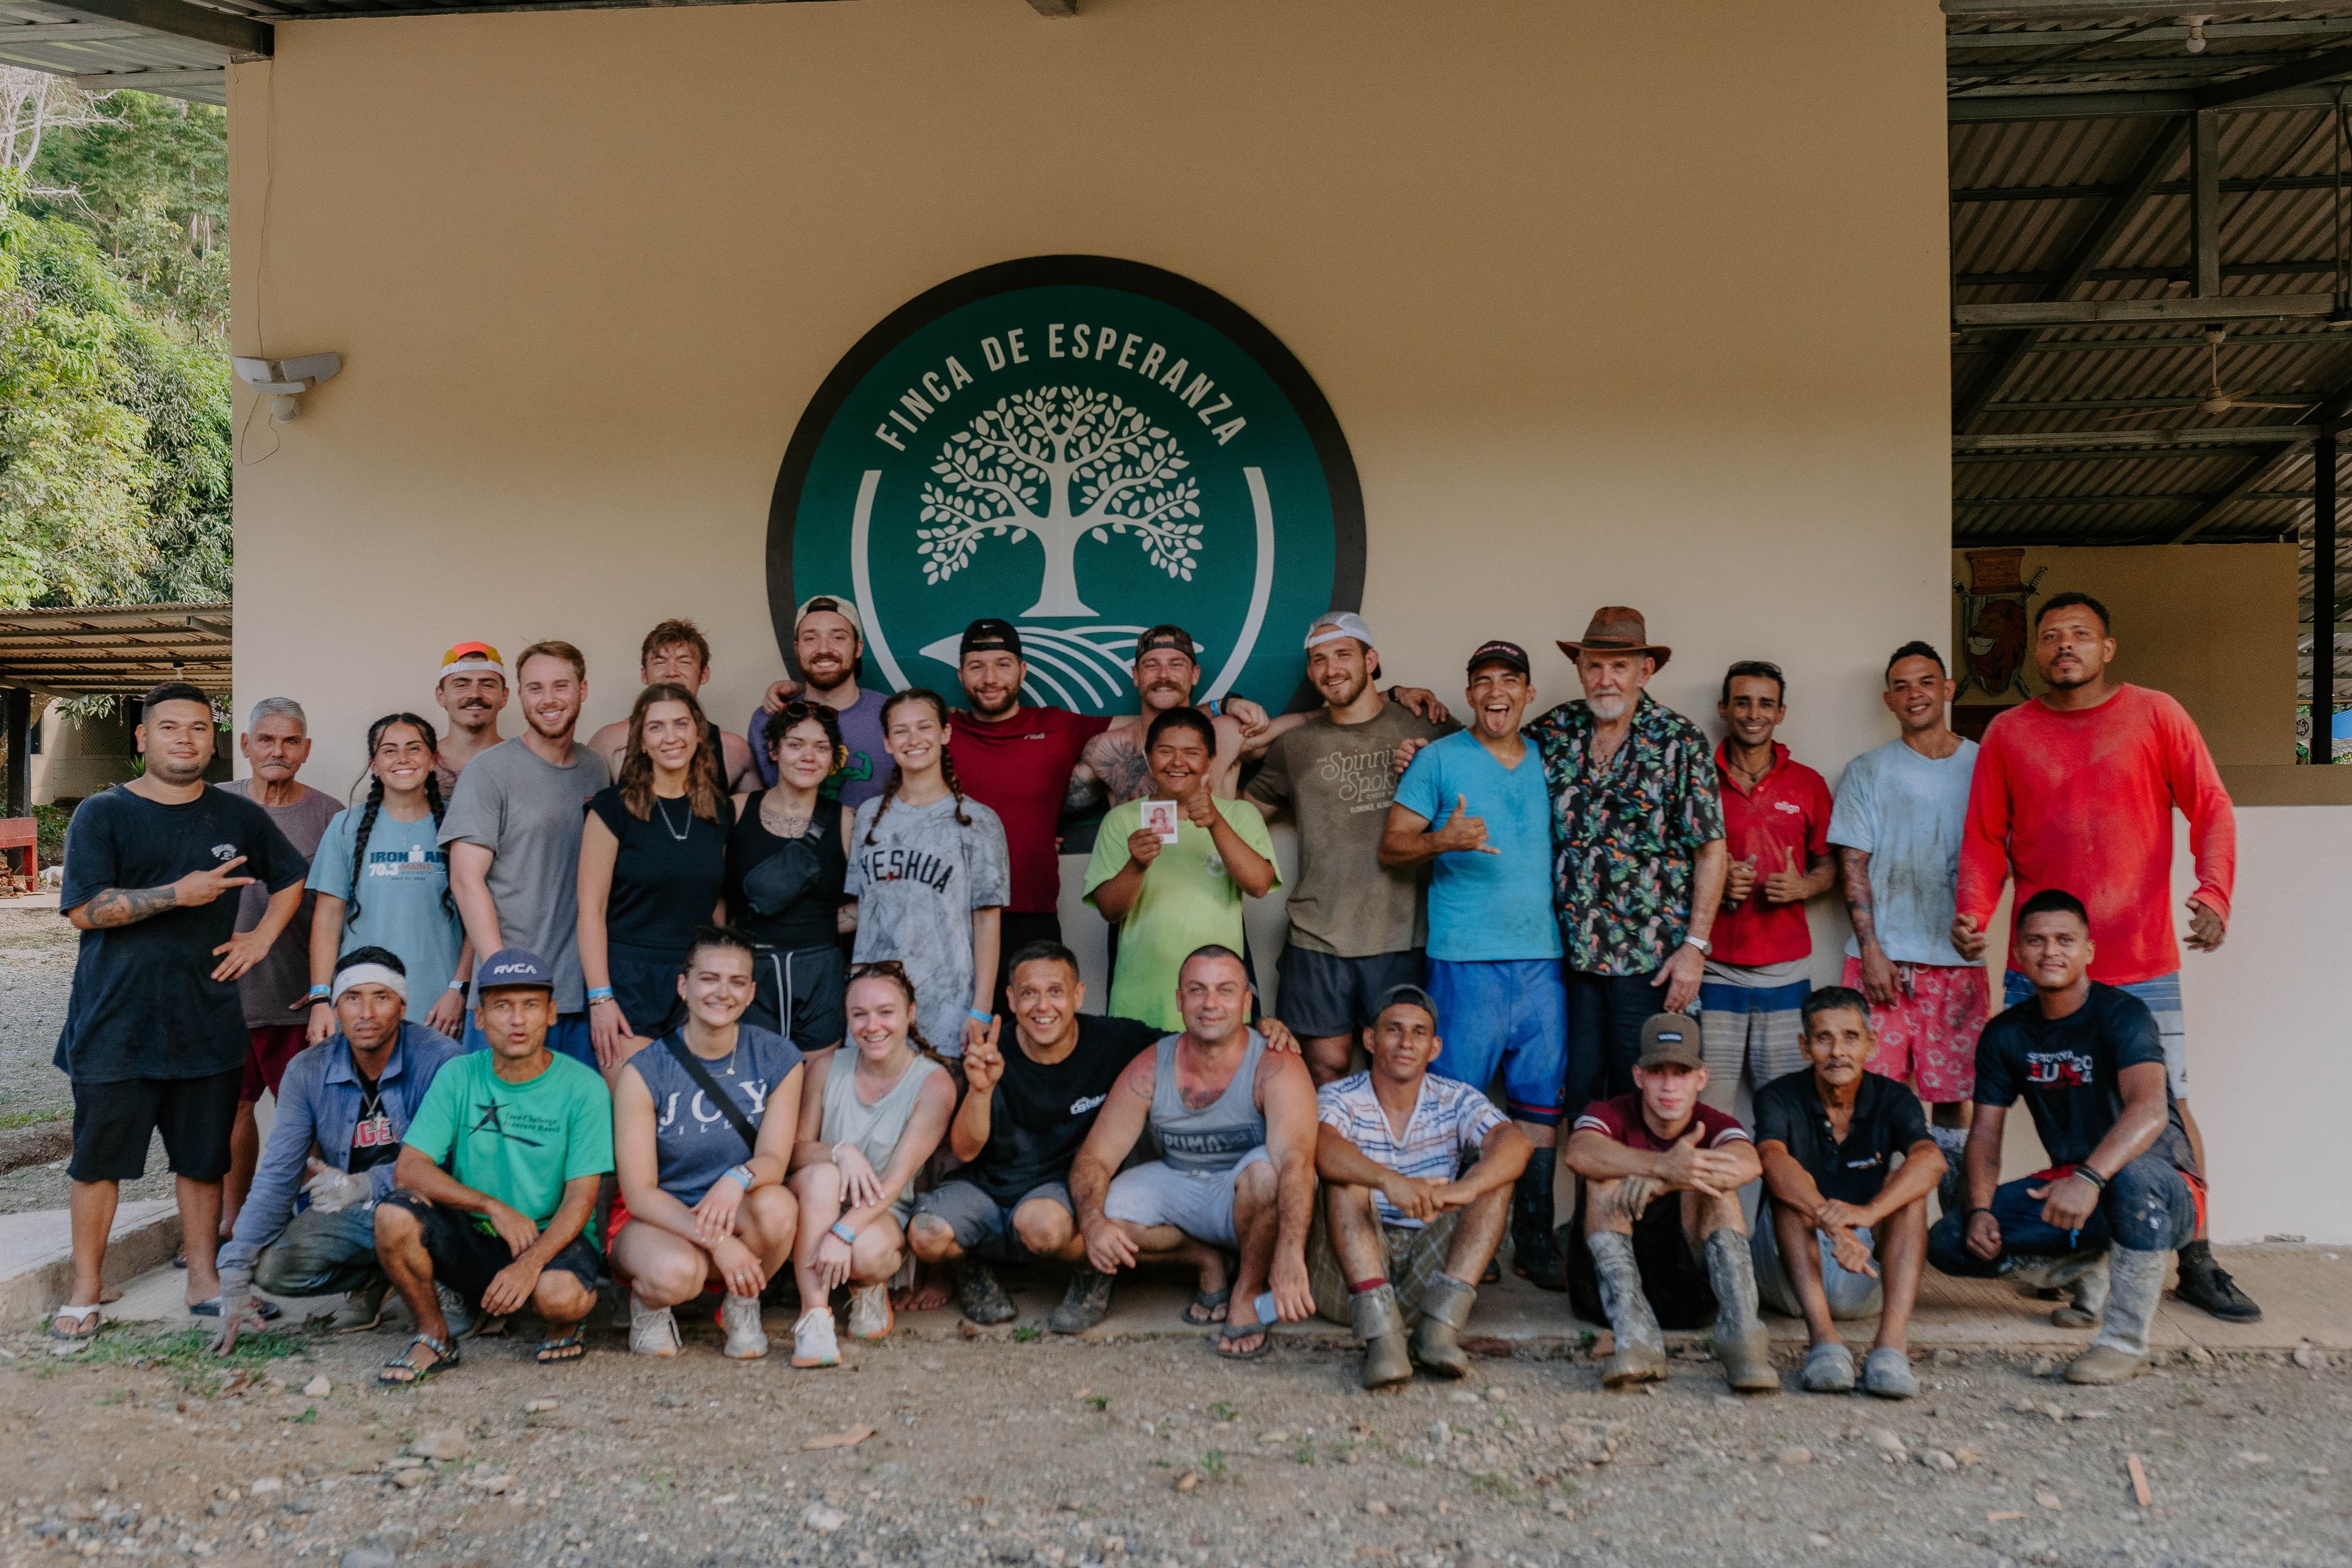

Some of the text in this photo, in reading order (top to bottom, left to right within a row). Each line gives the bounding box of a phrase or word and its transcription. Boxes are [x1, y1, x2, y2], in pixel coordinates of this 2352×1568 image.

[875, 323, 1246, 451] FINCA DE ESPERANZA
[1321, 743, 1396, 782] Spinni
[1338, 766, 1398, 802] Spok
[369, 862, 399, 876] 70.3
[861, 850, 953, 894] YESHUA
[493, 962, 537, 974] RVCA
